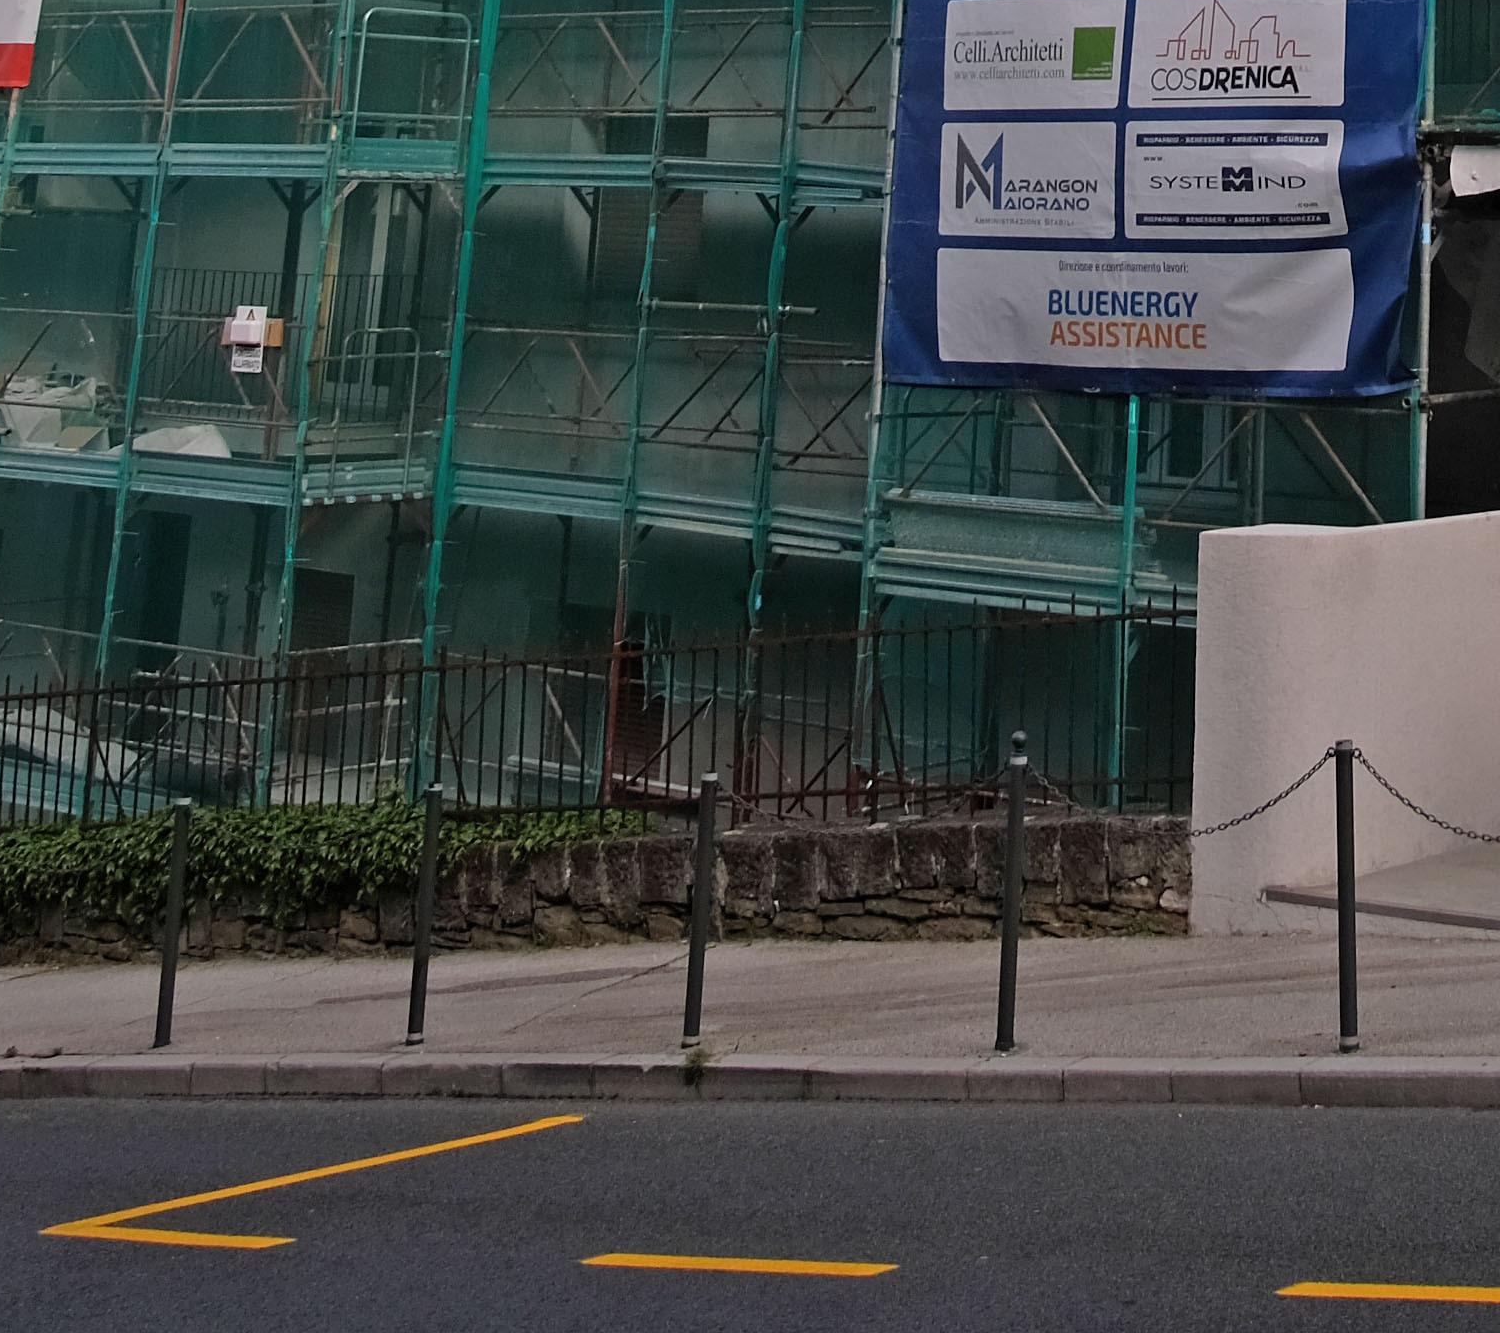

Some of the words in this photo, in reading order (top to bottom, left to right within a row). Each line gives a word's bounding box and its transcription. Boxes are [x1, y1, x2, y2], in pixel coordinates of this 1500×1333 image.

[953, 37, 1064, 64] Celli.Architetti
[1150, 65, 1300, 94] COSDRENICA
[1150, 167, 1307, 192] SYSTEMIND
[1047, 289, 1199, 318] BLUENERGY
[1049, 321, 1207, 350] ASSISTANCE
